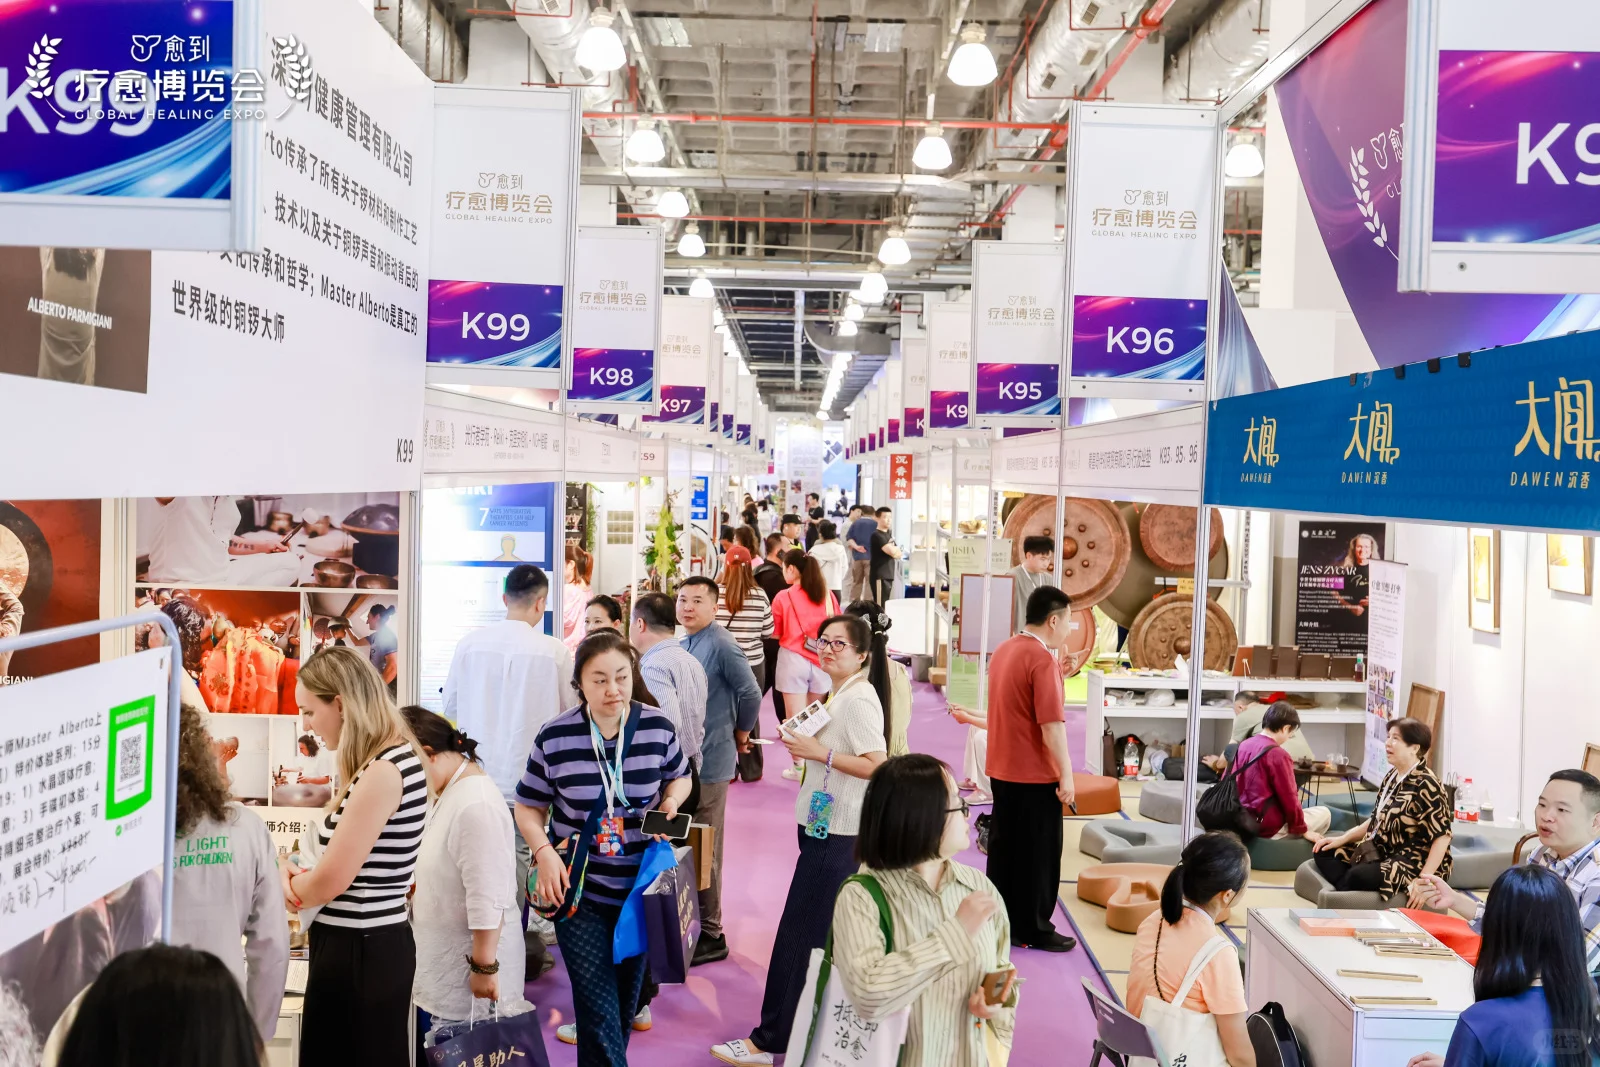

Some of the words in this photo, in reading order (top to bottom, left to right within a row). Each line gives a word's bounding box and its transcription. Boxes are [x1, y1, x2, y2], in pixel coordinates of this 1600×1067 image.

[497, 173, 523, 190] 愈到
[445, 190, 553, 214] 疗愈博览会
[1142, 191, 1168, 207] 愈到
[445, 213, 480, 221] GLOBAL
[485, 215, 524, 223] HEALING
[1092, 208, 1197, 230] 疗愈博览会
[1092, 229, 1125, 237] GLOBAL
[1130, 231, 1169, 239] HEALING
[580, 291, 647, 306] 疗愈博览会
[27, 297, 66, 320] ALBERTO
[67, 306, 112, 330] PARMIGIANI
[172, 280, 285, 343] 世界级的铜锣大师
[988, 307, 1055, 320] 疗愈博览会
[461, 312, 530, 341] K99
[1106, 326, 1175, 356] K96
[590, 367, 634, 386] K98
[999, 381, 1042, 400] K95
[660, 399, 691, 413] K97
[396, 439, 414, 463] K99
[1341, 471, 1371, 483] DAWEN
[1373, 471, 1387, 485] 沉香
[1510, 471, 1563, 487] DAWEN
[1568, 471, 1590, 489] 沉香
[479, 507, 489, 527] 7
[1301, 565, 1323, 575] JENS
[1324, 565, 1357, 576] ZYGAR
[187, 837, 228, 853] LIGHT
[180, 854, 195, 867] FOR
[196, 852, 233, 866] CHILDREN
